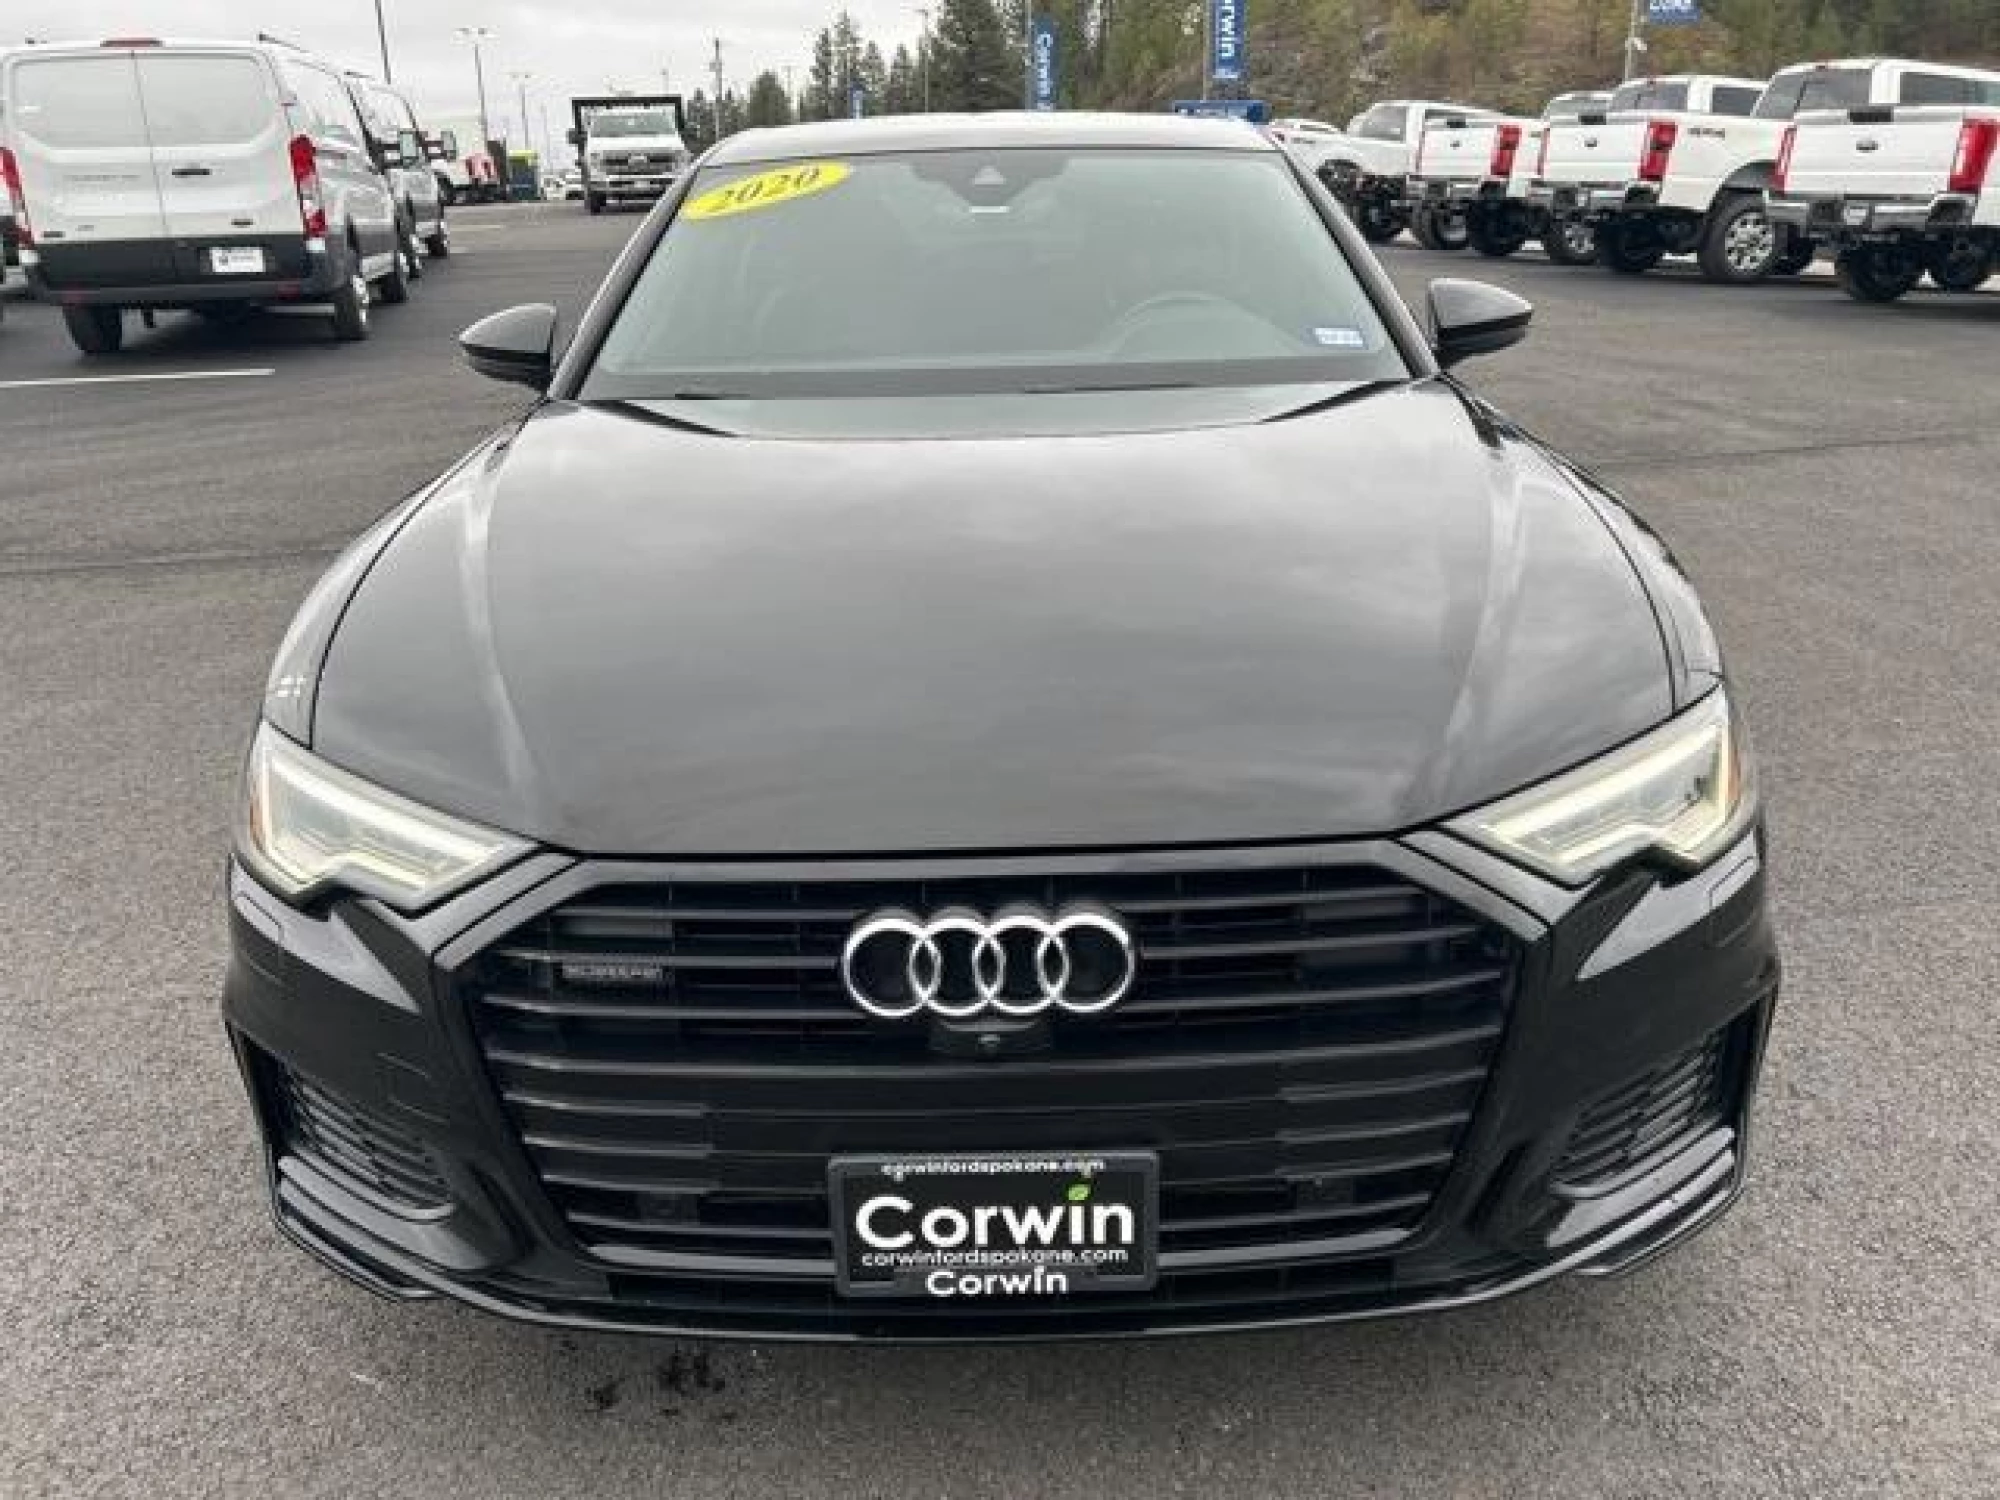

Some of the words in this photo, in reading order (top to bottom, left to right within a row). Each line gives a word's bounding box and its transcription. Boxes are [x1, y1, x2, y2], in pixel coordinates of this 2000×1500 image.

[707, 166, 821, 212] 2020
[856, 1184, 1134, 1249] Corwin
[925, 1265, 1069, 1295] Corwin
